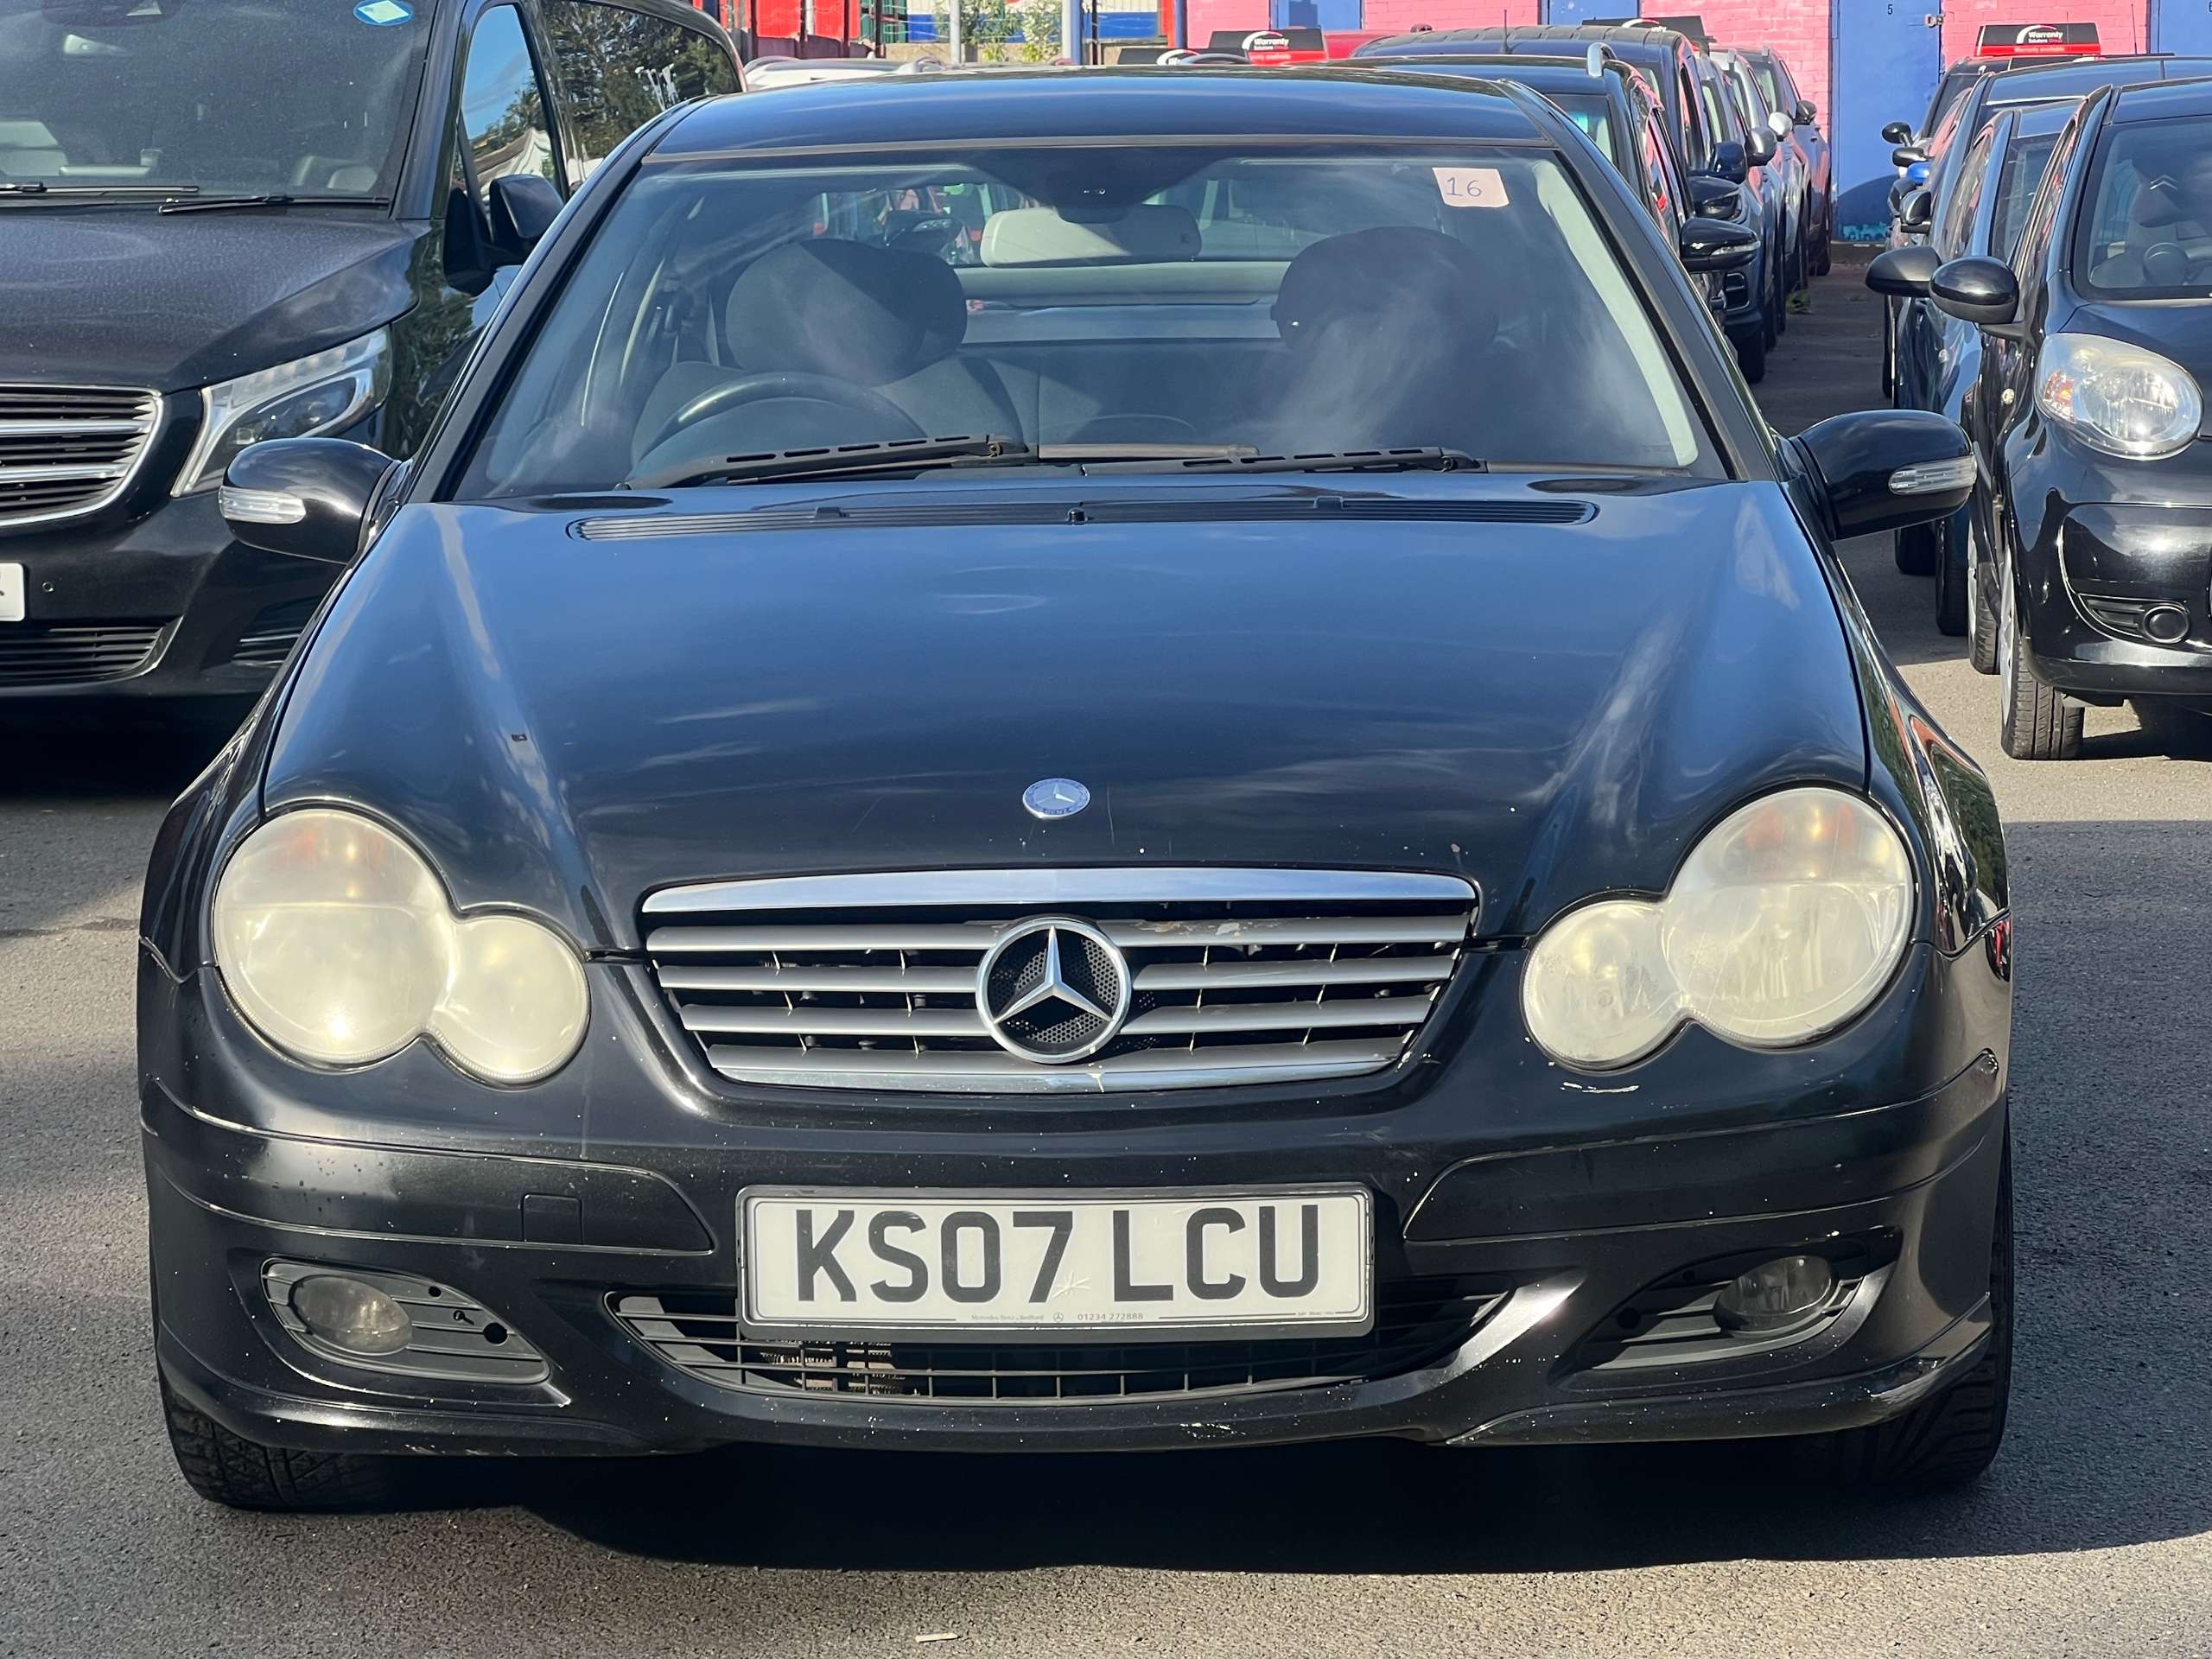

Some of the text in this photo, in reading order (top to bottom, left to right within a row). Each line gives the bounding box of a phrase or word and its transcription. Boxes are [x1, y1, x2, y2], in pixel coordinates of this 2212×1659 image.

[1887, 3, 1893, 16] 5
[2028, 31, 2063, 40] Warranty
[1254, 38, 1289, 47] Warranty
[1446, 176, 1483, 197] 16
[796, 1205, 1319, 1303] KS07 LCU
[1077, 1312, 1144, 1321] 01234 272888
